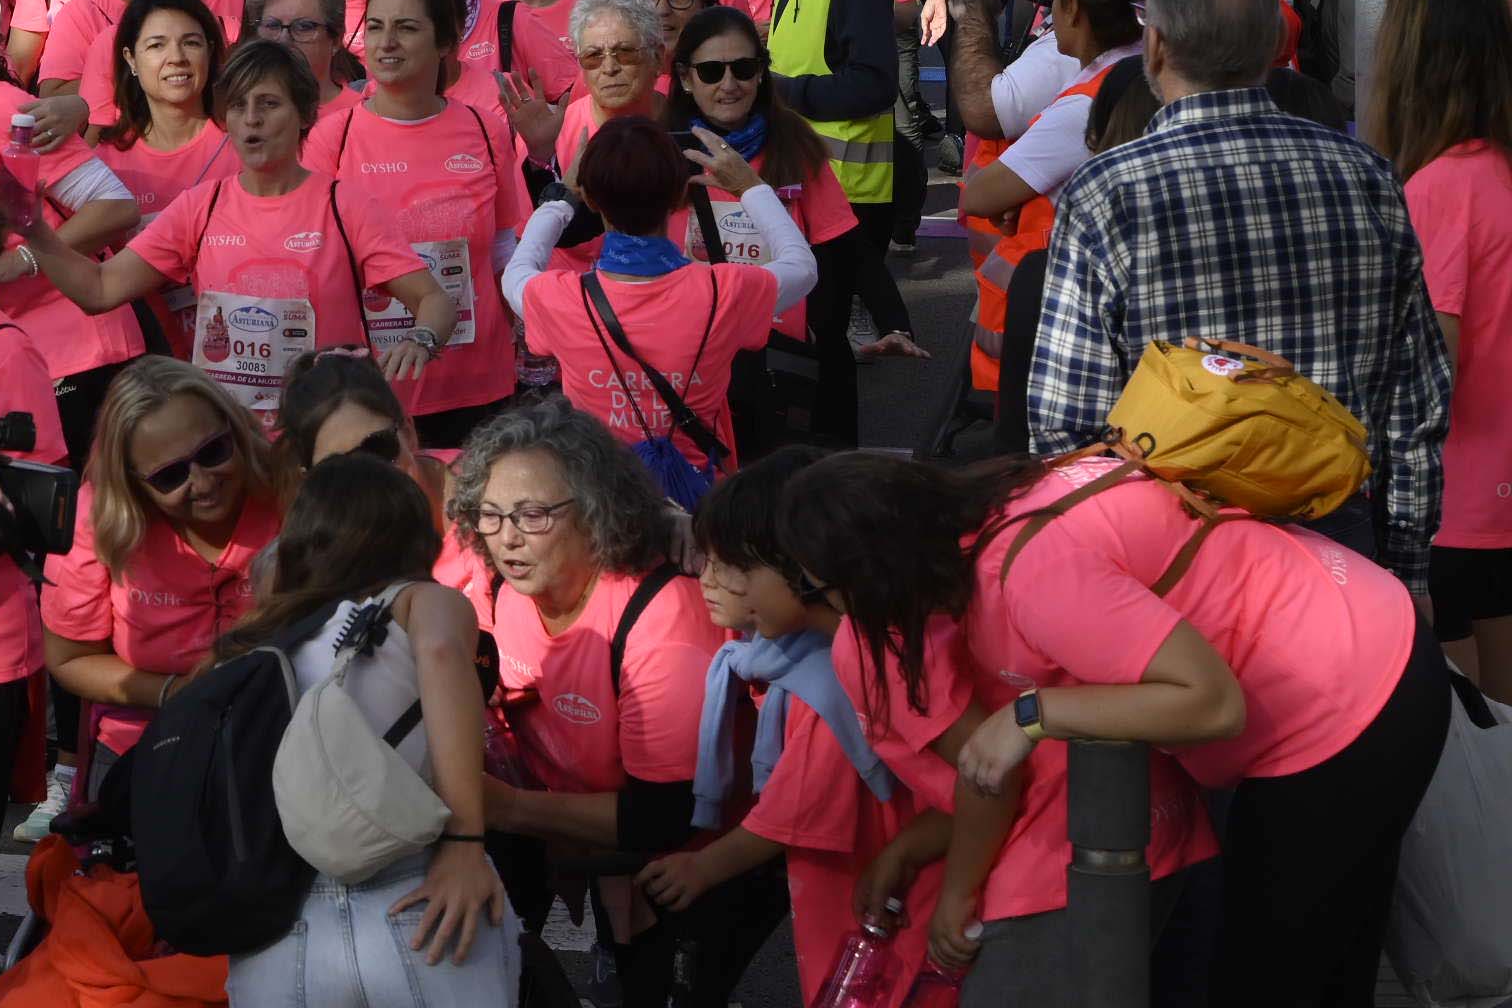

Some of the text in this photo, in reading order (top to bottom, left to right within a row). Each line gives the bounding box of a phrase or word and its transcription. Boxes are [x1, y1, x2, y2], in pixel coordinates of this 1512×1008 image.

[361, 162, 408, 176] OYSHO
[722, 241, 761, 258] 016
[232, 313, 276, 328] ASTURIANA
[283, 313, 307, 321] SUMA
[370, 321, 403, 329] CARRERA
[233, 340, 272, 358] 016
[236, 361, 267, 373] 30083
[238, 375, 247, 383] DE
[248, 376, 257, 384] LA
